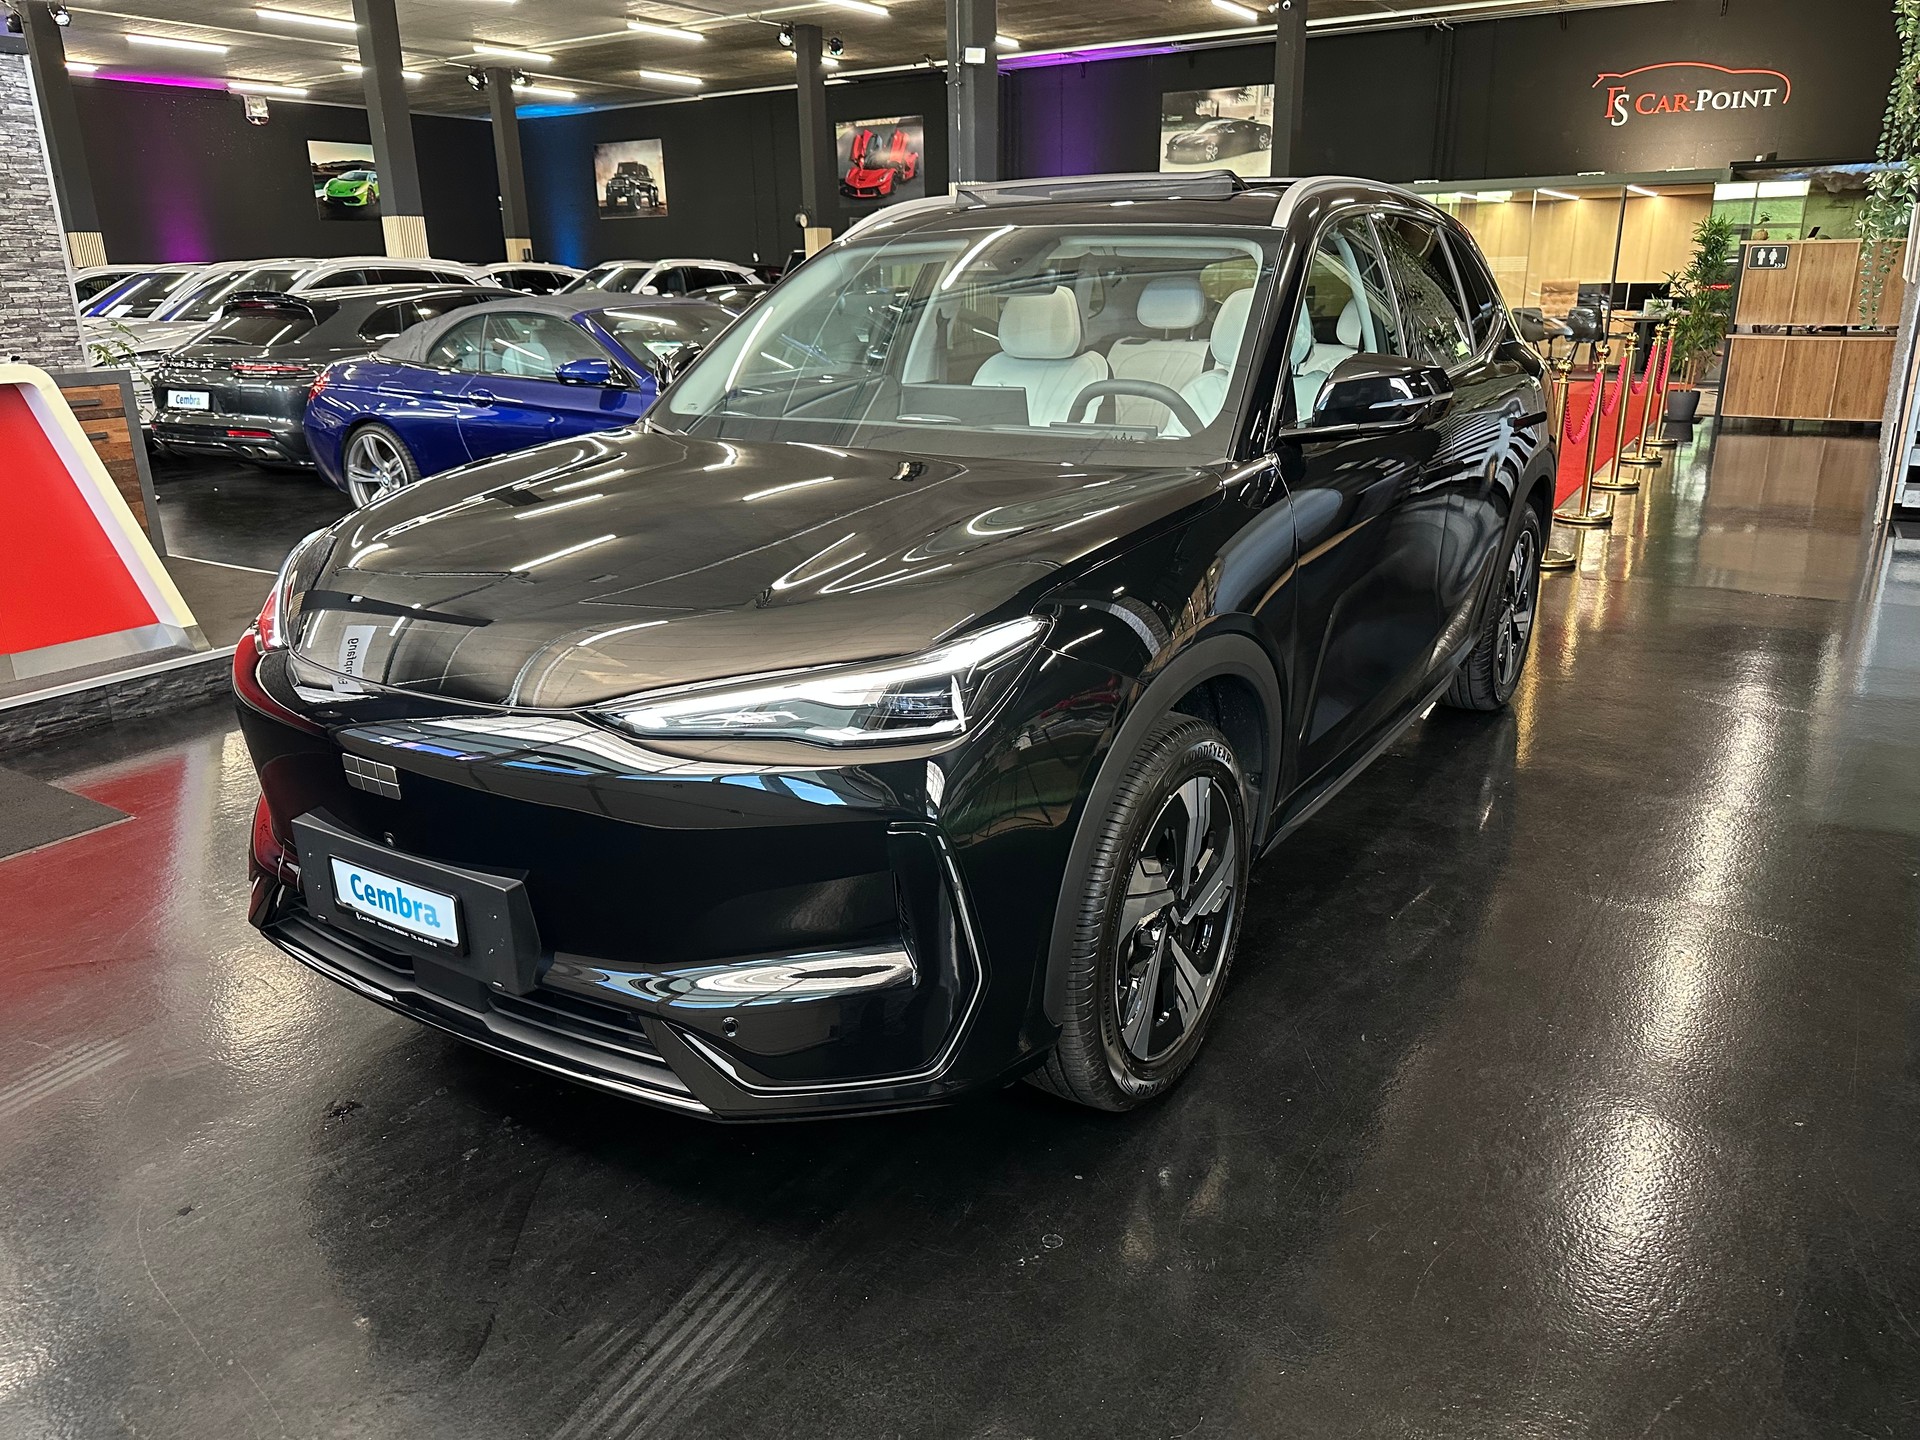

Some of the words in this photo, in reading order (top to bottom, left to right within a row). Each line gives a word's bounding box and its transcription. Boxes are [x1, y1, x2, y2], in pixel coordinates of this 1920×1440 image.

[1634, 87, 1778, 115] CAR-POINT
[175, 394, 201, 406] Cembra
[350, 873, 441, 929] Cembra
